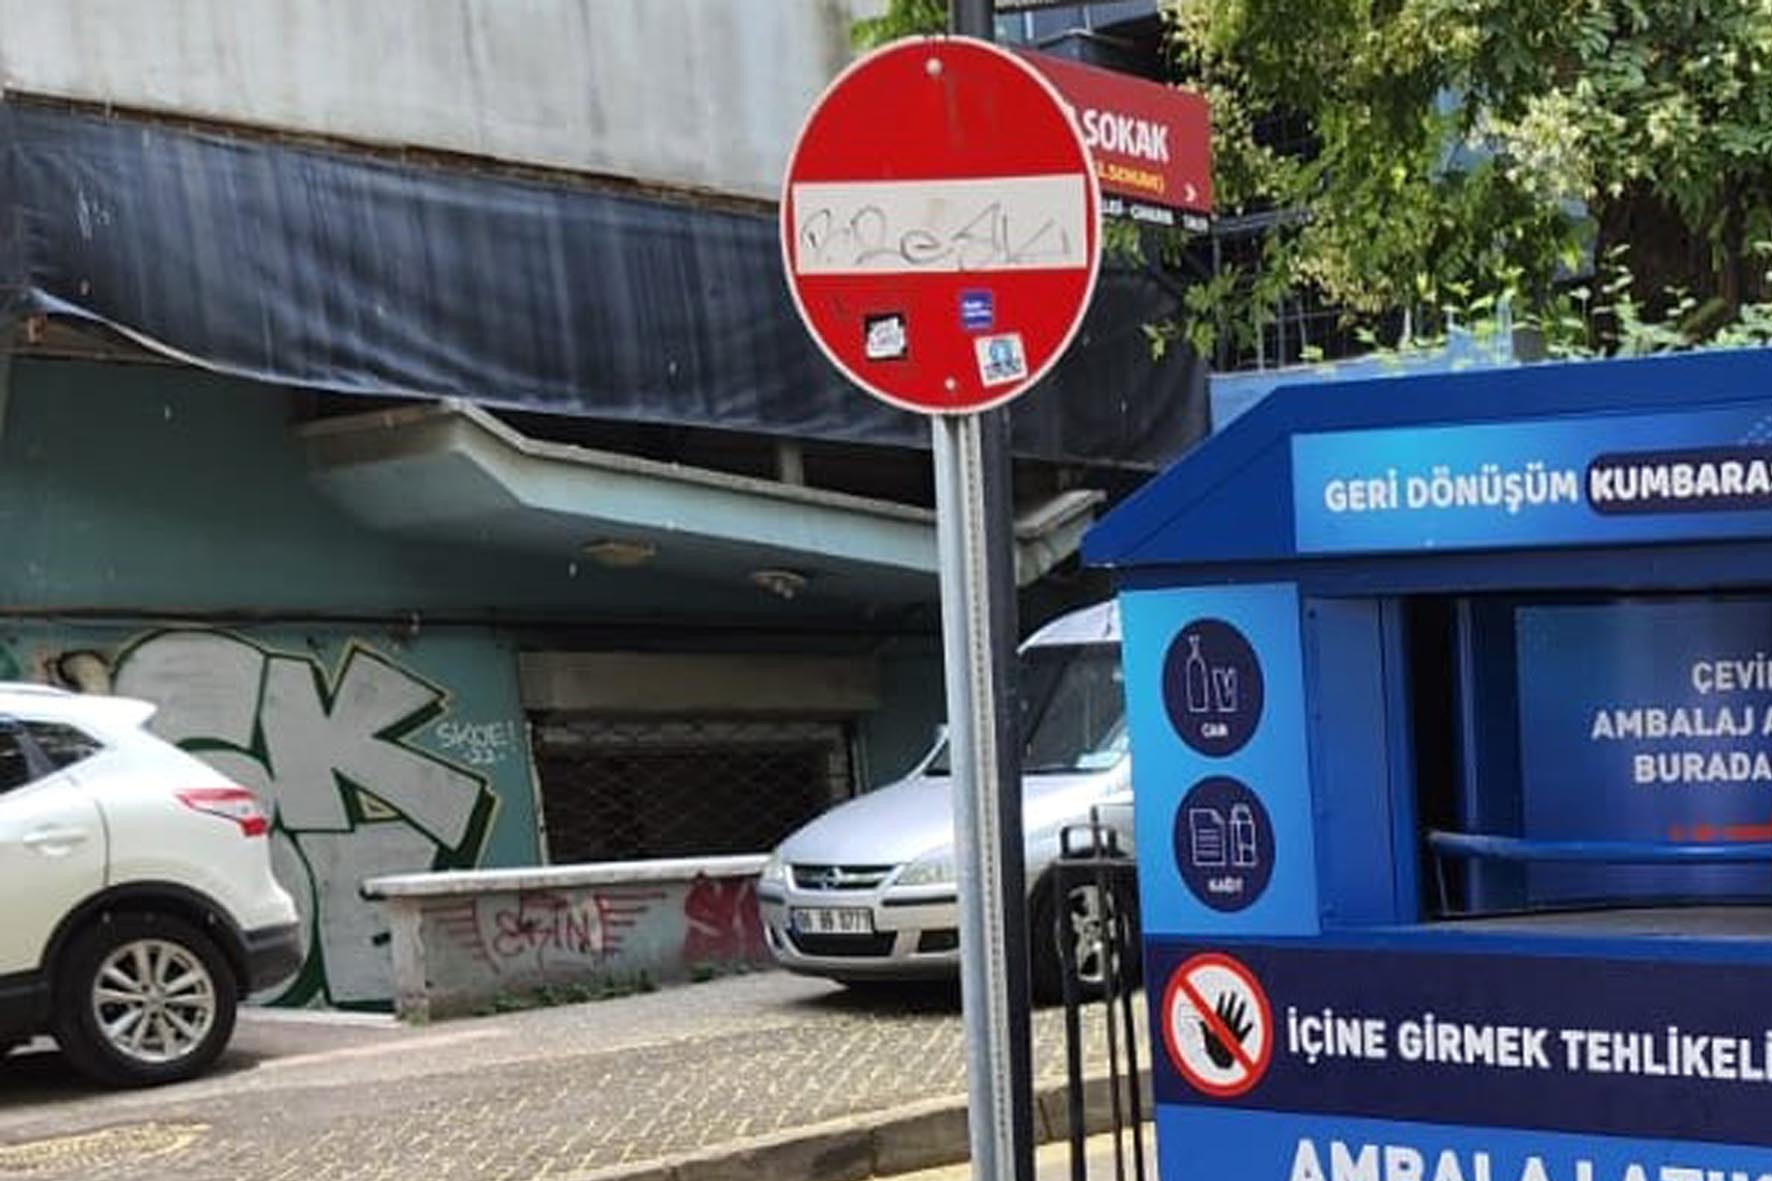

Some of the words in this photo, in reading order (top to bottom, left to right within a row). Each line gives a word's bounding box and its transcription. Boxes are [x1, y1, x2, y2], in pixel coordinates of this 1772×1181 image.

[1083, 108, 1169, 163] SOKAK
[1324, 475, 1399, 513] GERİ
[1407, 465, 1579, 516] DÖNÜŞÜM
[1201, 722, 1229, 740] CAM
[1591, 707, 1754, 741] AMBALAJ
[1287, 1006, 1388, 1066] İÇİNE
[1397, 1012, 1551, 1070] GİRMEK
